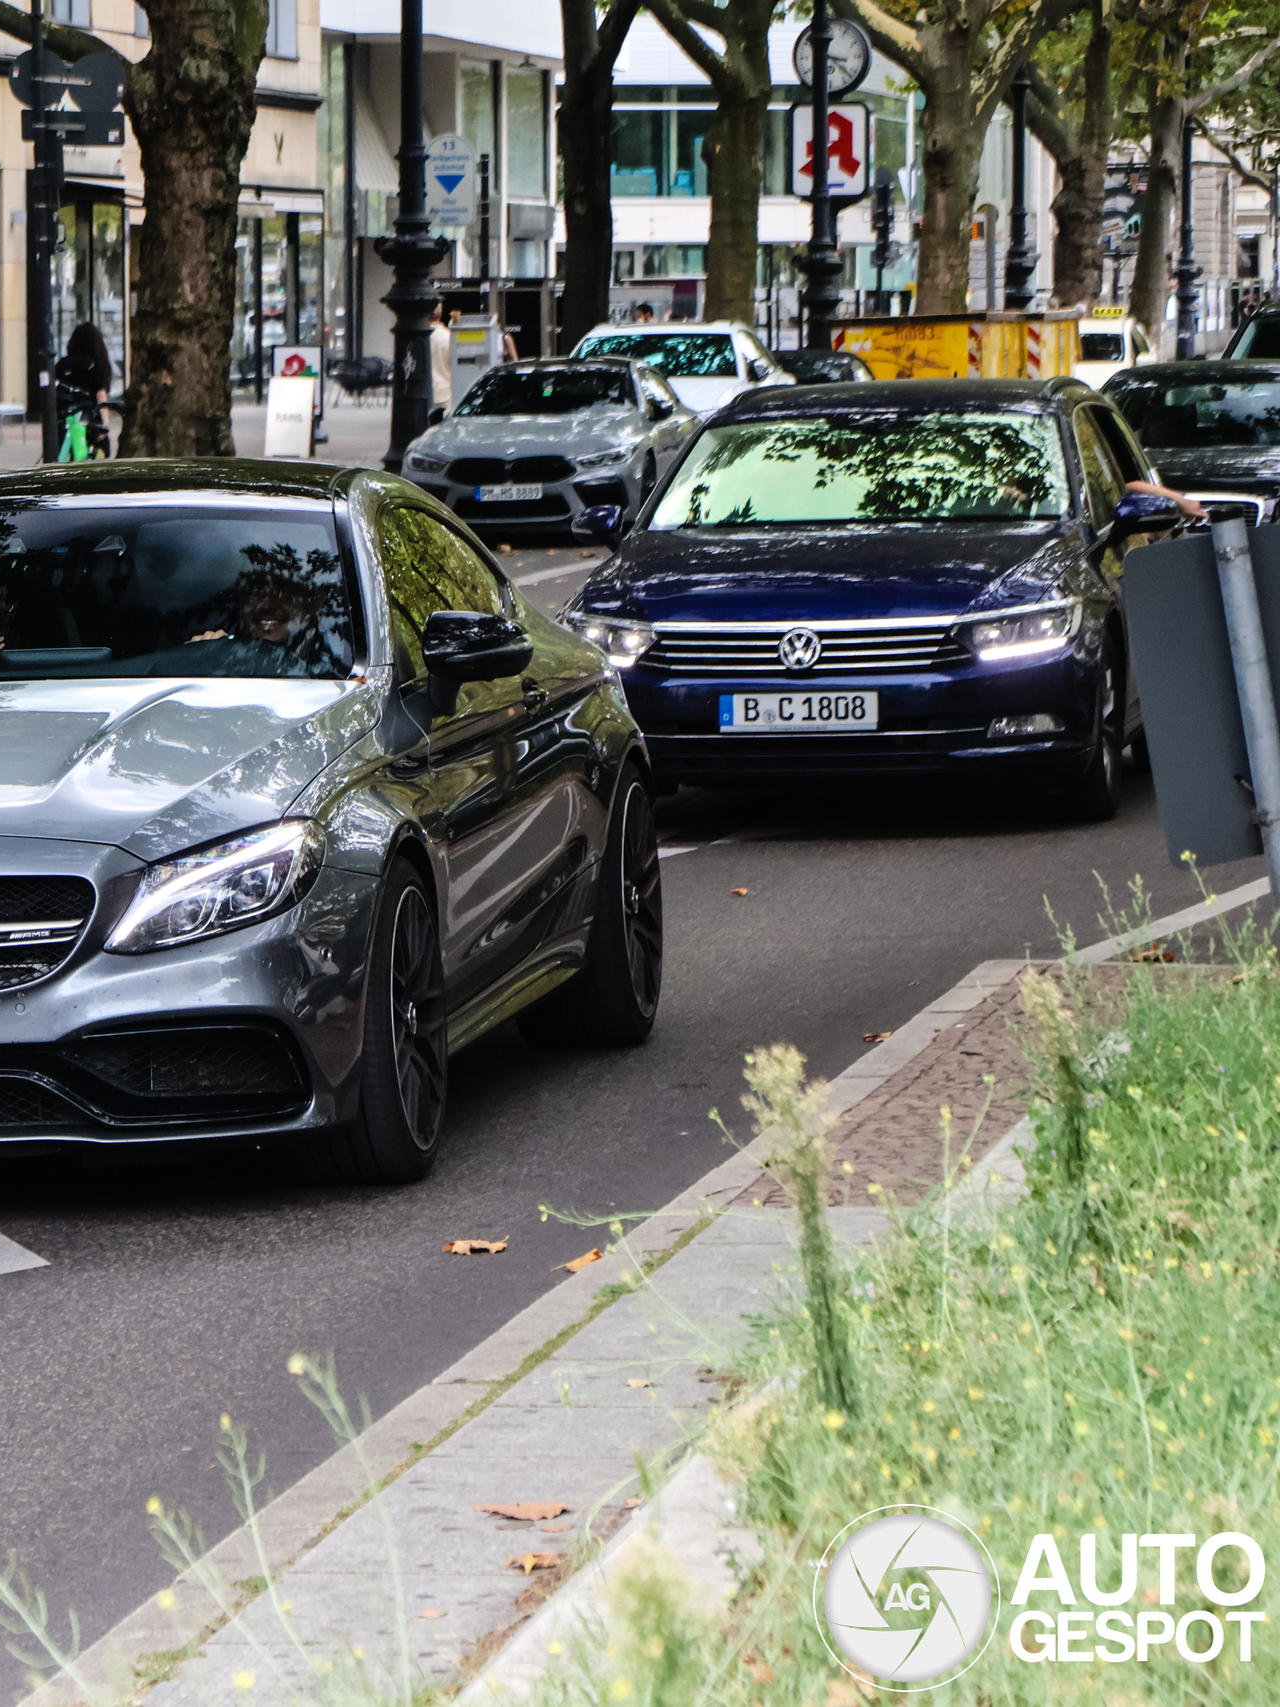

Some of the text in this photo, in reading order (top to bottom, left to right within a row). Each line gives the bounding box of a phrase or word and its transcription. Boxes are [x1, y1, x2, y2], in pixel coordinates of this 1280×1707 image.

[442, 141, 456, 151] 13
[744, 697, 760, 722] B
[779, 697, 795, 722] C
[801, 696, 866, 722] 1808
